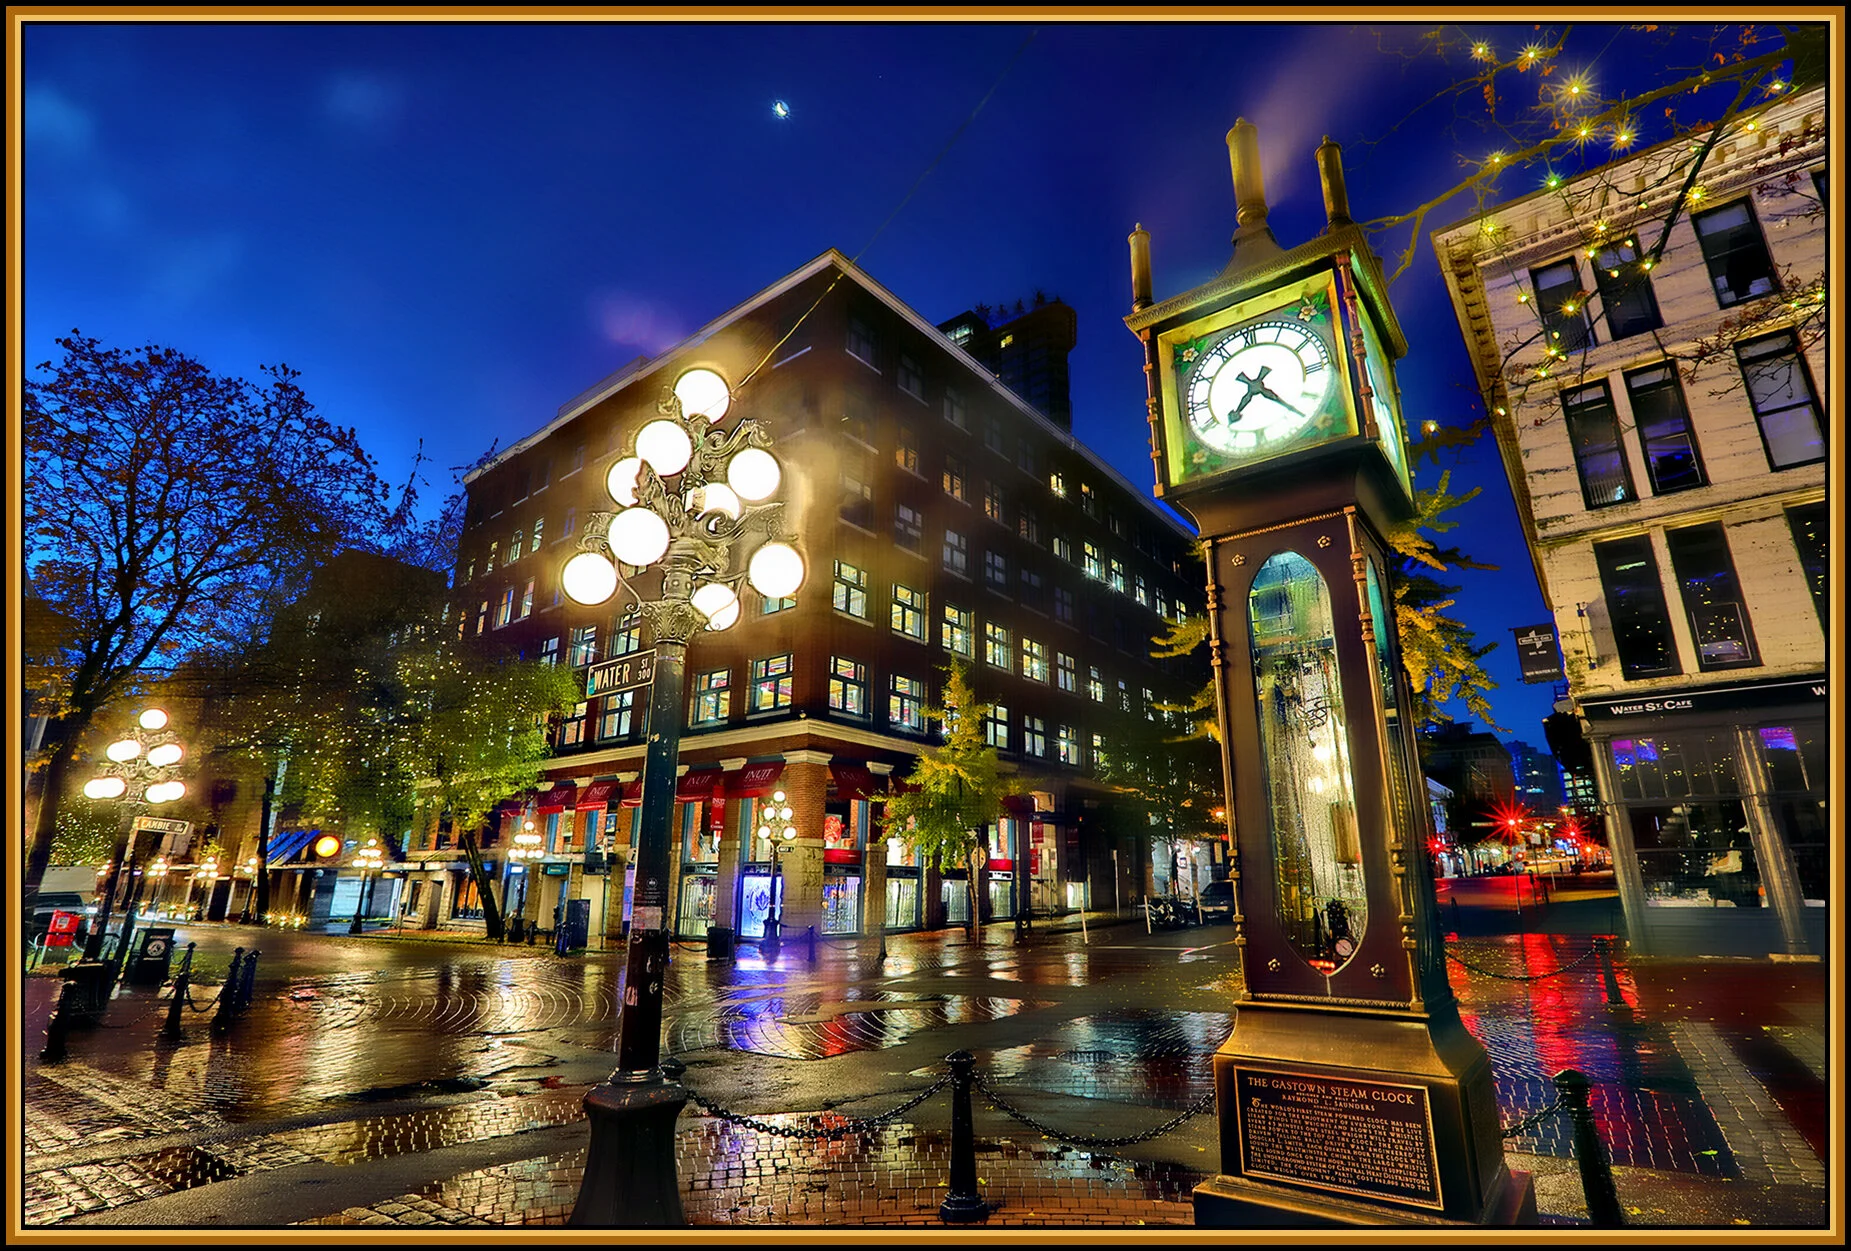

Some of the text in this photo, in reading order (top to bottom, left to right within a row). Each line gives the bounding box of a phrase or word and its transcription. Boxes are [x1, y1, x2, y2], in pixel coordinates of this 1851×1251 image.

[594, 658, 649, 691] WATER ST
[637, 668, 652, 680] 300
[745, 768, 774, 780] INUIT
[141, 820, 172, 831] CAMBIE
[1247, 1076, 1414, 1104] THE GASTOWN STEAM CLOCK
[1281, 1094, 1319, 1104] RAYMOND
[1334, 1100, 1375, 1111] SAUNDERS
[1301, 1114, 1337, 1123] ENJOYMENT
[1304, 1120, 1331, 1128] WEIGHTS
[1335, 1113, 1364, 1121] POWERED
[1277, 1122, 1303, 1130] MINUTES
[1341, 1131, 1366, 1139] WEIGHT
[1387, 1137, 1412, 1146] TRAVEL
[1248, 1134, 1274, 1142] DOUGLAS
[1323, 1145, 1351, 1154] QUARTER
[1385, 1154, 1408, 1162] CLOCK
[1394, 1144, 1425, 1153] GRAVITY
[1285, 1145, 1327, 1156] WESTMINSTER
[1372, 1158, 1394, 1167] LARGE
[1397, 1162, 1427, 1172] WHISTLE
[1263, 1153, 1305, 1164] UNDERGROUND
[1306, 1160, 1326, 1168] SYSTEM
[1336, 1164, 1365, 1174] CENTRAL
[1365, 1169, 1382, 1177] HEAT
[1383, 1172, 1430, 1185] DISTRIBUTORS
[1274, 1166, 1297, 1174] WEIGHS
[1361, 1162, 1380, 1170] STEAM
[1388, 1167, 1418, 1176] SUPPLIED
[1293, 1164, 1330, 1174] COMPONENT
[1356, 1174, 1373, 1182] COST
[1400, 1181, 1415, 1189] AND
